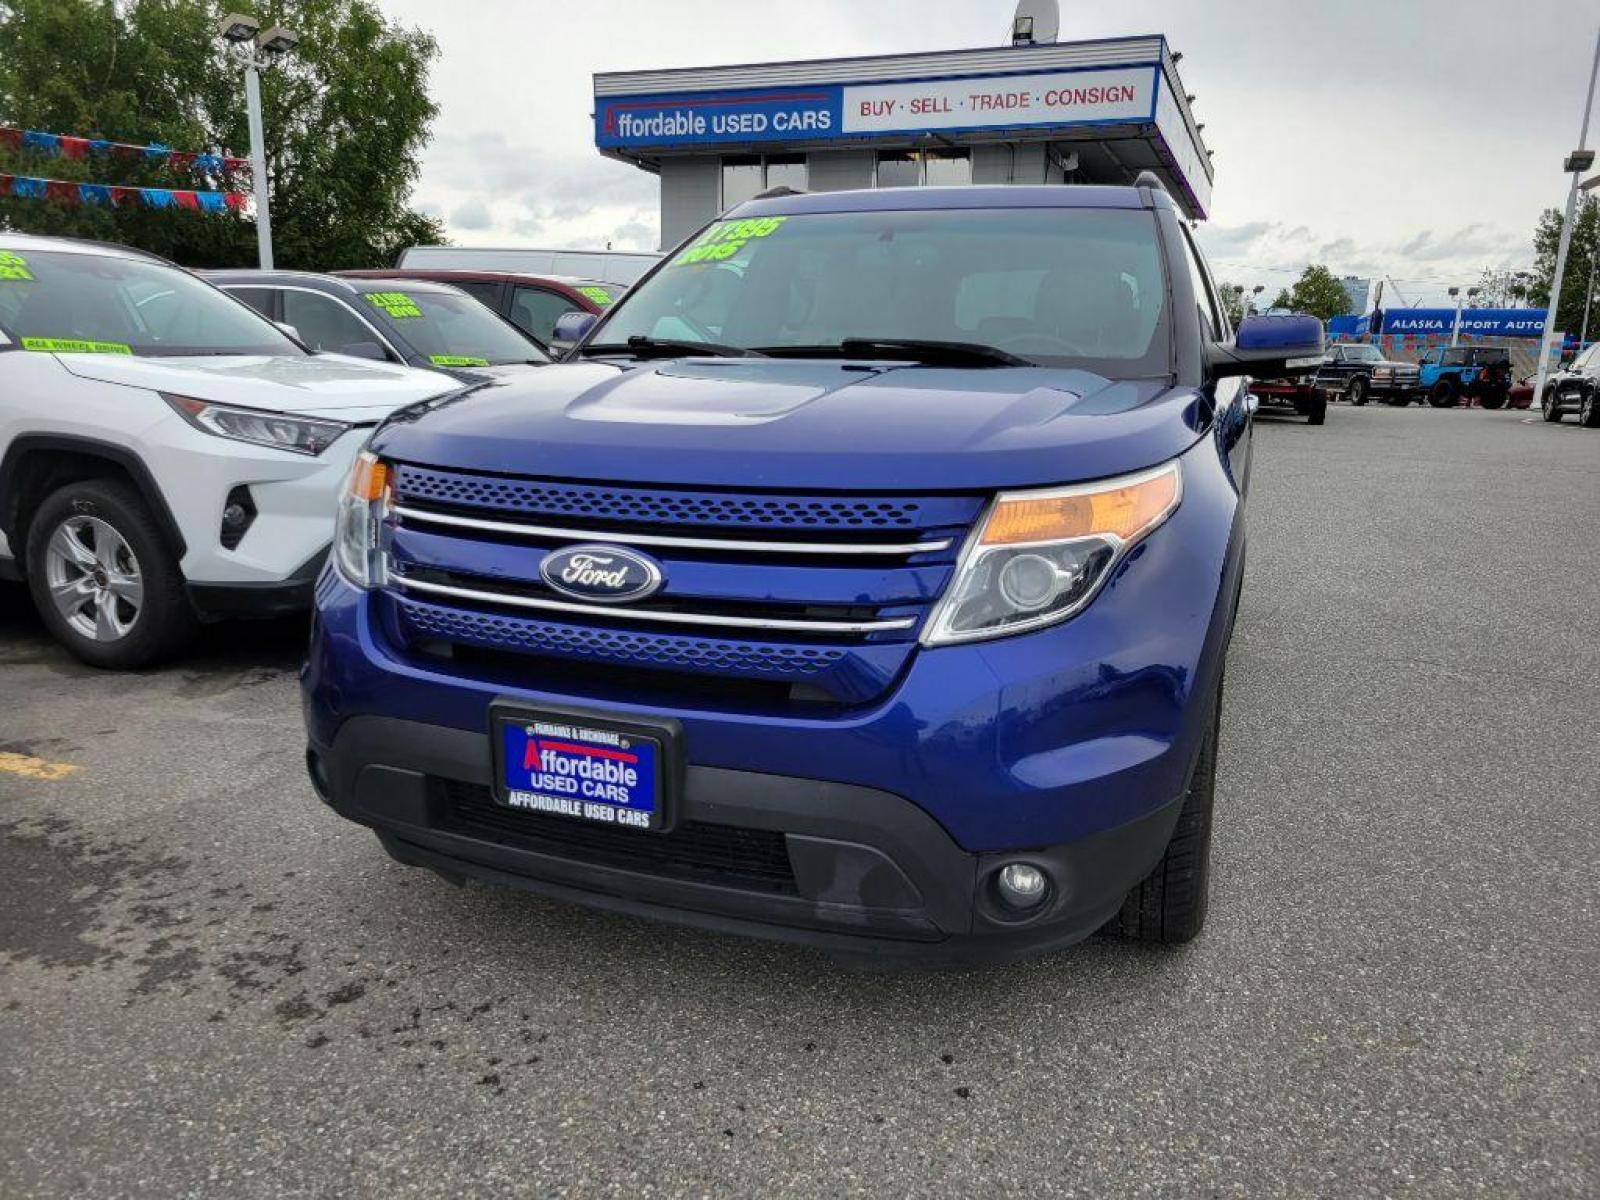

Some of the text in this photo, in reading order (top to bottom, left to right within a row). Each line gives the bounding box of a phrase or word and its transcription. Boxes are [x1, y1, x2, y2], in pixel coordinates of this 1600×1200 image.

[860, 86, 1134, 117] BUY SELL TRADE CONSIGN
[604, 105, 832, 137] Affordable USED CARS
[1391, 319, 1443, 329] ALASKA
[1505, 320, 1545, 330] AUTO
[562, 554, 629, 588] Ford
[524, 739, 637, 787] Affordable
[530, 772, 629, 804] USED CARS
[508, 791, 650, 828] AFFORDABLE USED CARS
